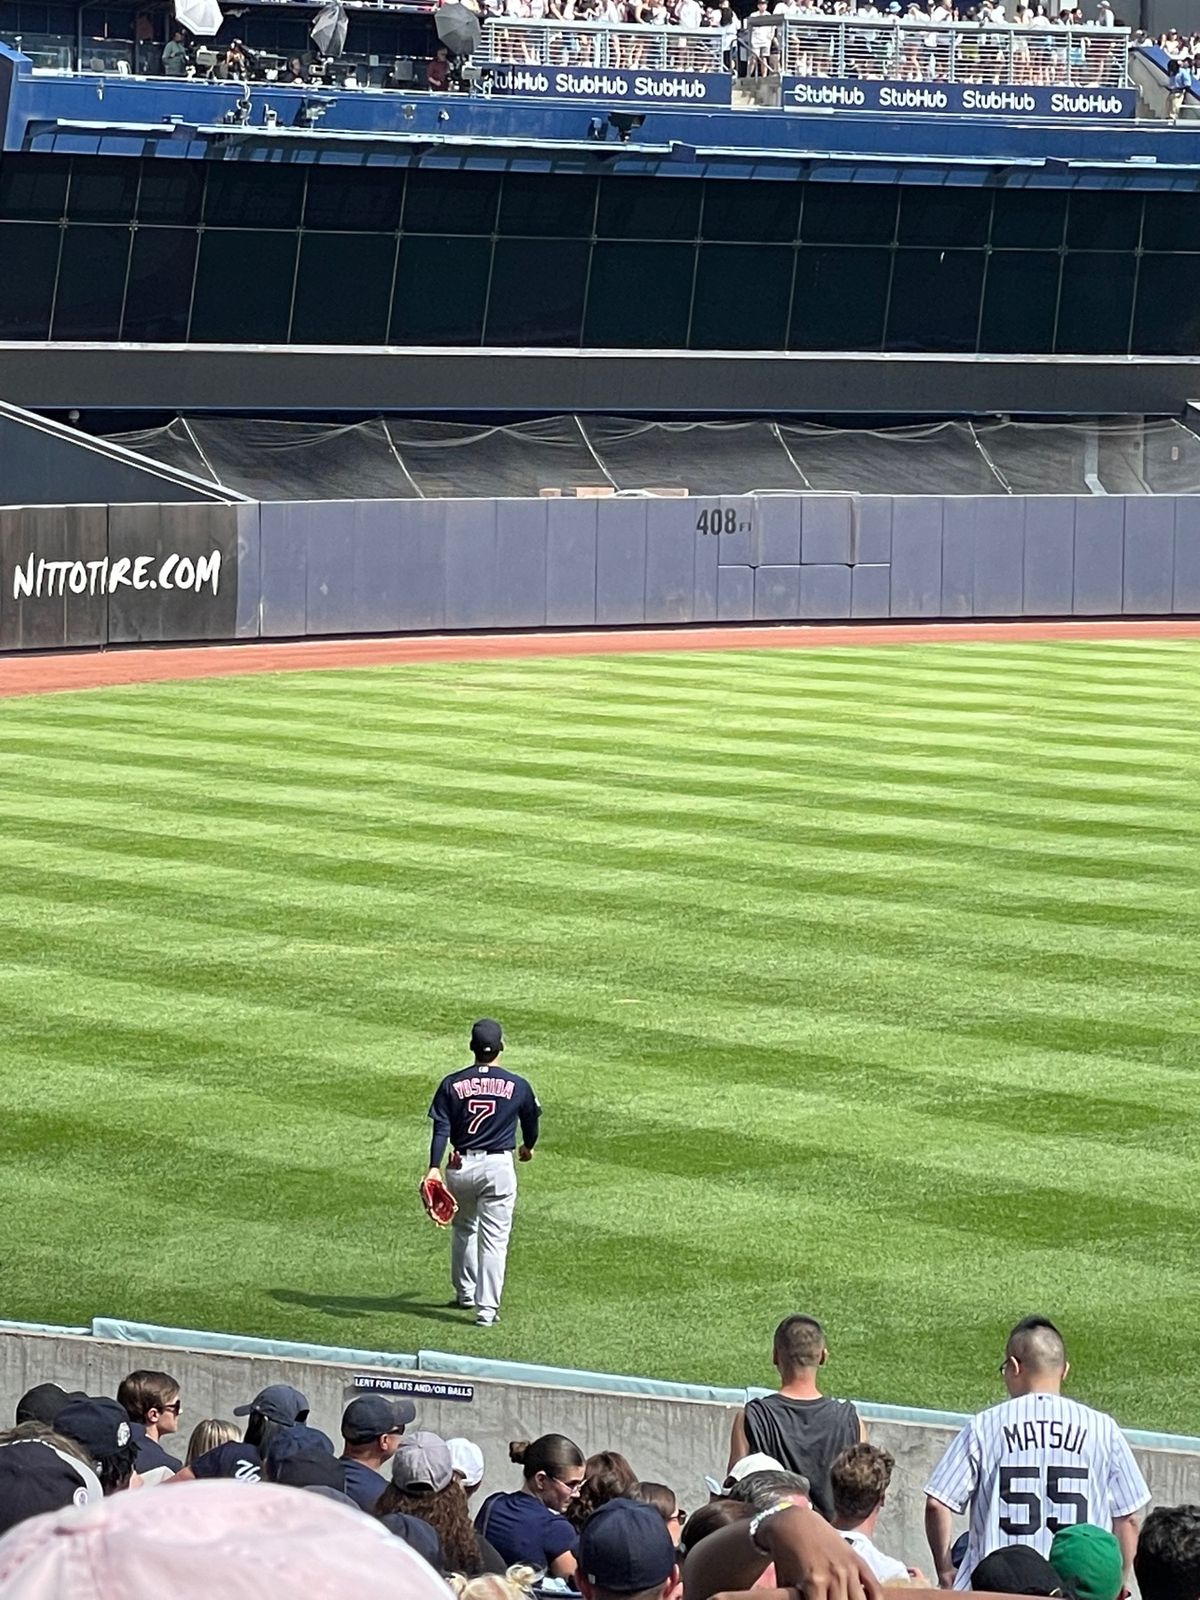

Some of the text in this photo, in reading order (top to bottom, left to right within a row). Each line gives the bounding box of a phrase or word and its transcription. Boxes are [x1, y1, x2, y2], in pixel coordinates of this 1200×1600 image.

[492, 70, 706, 98] tubHub StubHub StubHub
[794, 84, 1122, 114] StubHub StubHub StubHub StubHub
[696, 508, 736, 535] 408
[13, 550, 221, 599] NITTOTIRE.COM
[453, 1078, 515, 1099] YOSHIDA
[468, 1100, 496, 1134] 7
[375, 1380, 391, 1389] FOR
[392, 1382, 413, 1391] BATS
[448, 1386, 472, 1397] BALLS
[1003, 1421, 1087, 1454] MATSUI
[999, 1466, 1089, 1535] 55
